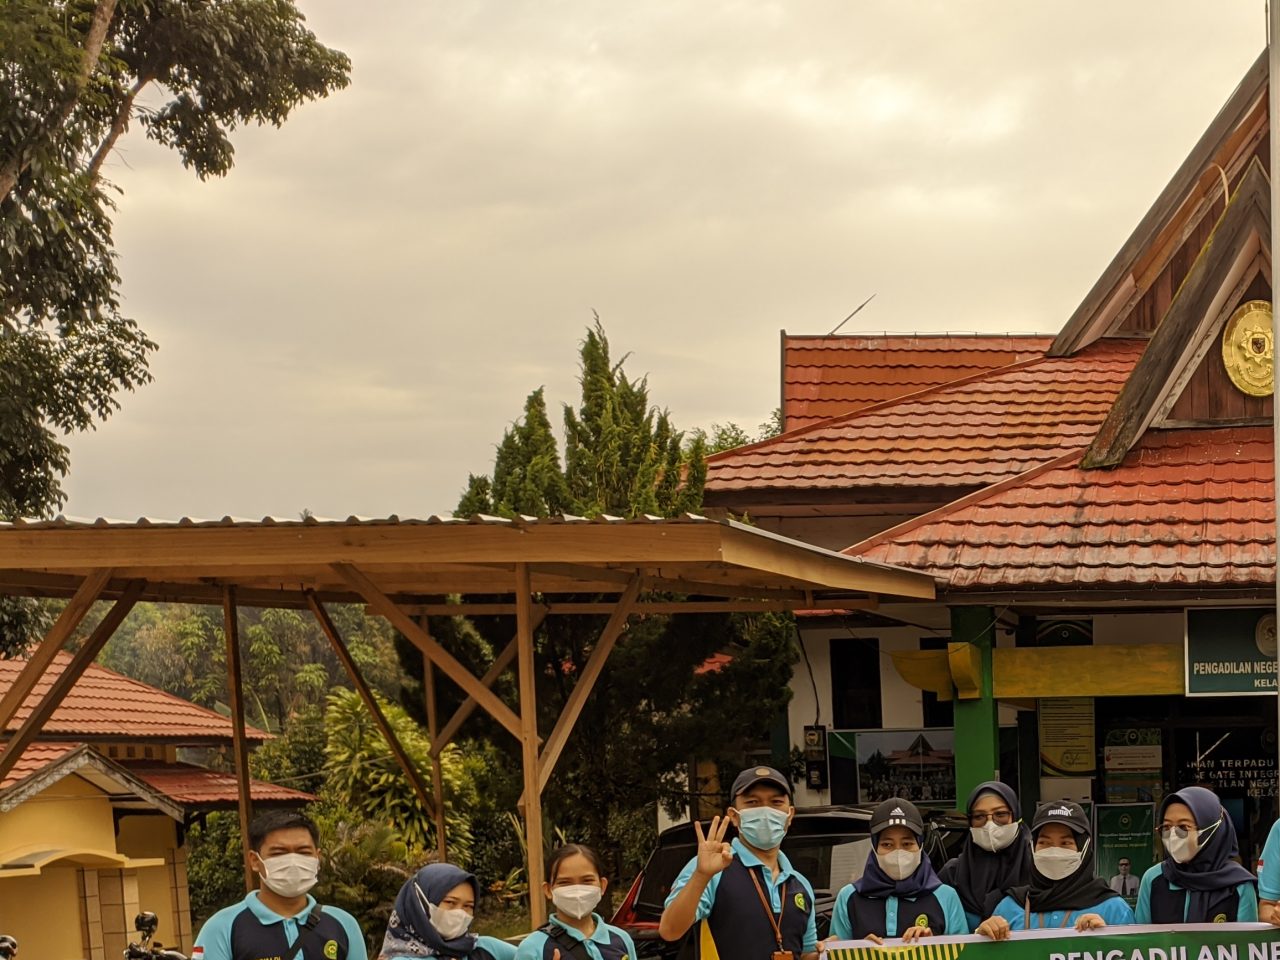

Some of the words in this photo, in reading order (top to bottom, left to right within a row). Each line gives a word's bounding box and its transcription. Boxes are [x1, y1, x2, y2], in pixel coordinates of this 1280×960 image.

[1193, 662, 1252, 675] PENGADILAN
[1253, 661, 1280, 674] NEGE
[1254, 678, 1279, 688] KELA
